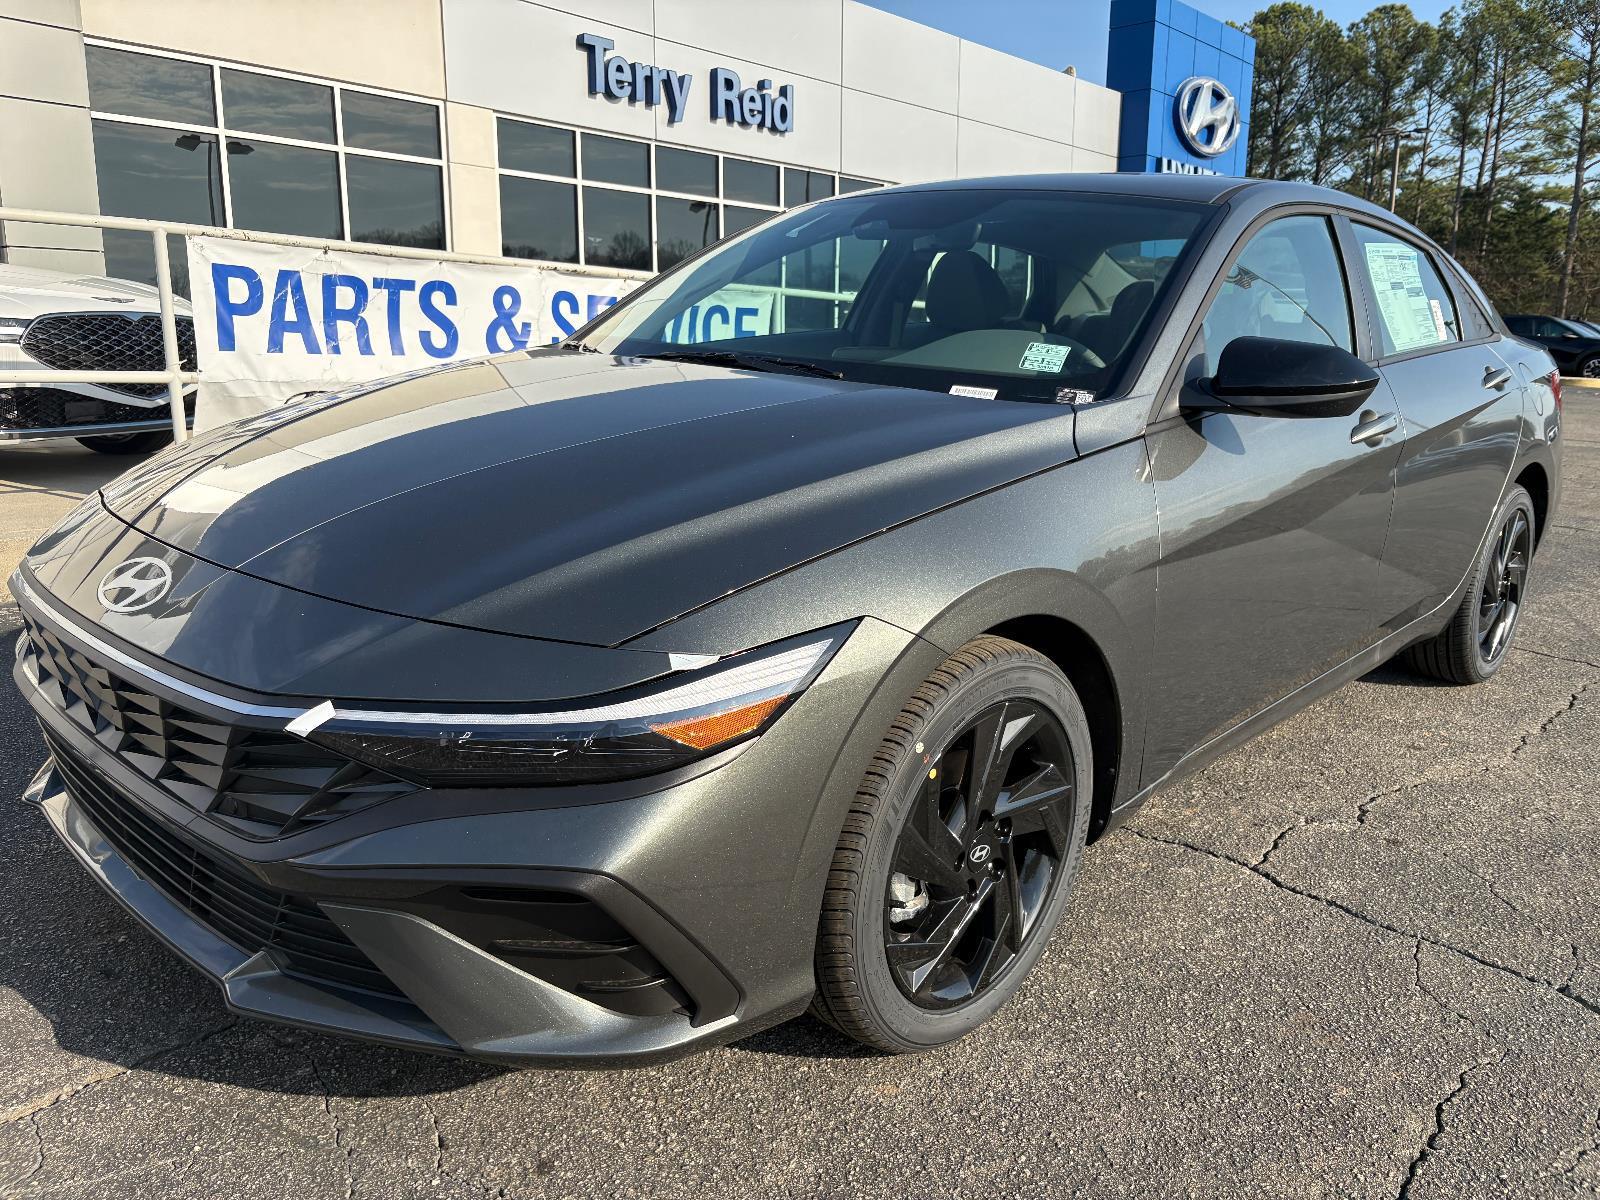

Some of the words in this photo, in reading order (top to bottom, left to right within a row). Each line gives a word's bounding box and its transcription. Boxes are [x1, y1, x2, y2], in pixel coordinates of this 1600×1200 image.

[576, 33, 693, 124] Terry
[709, 67, 795, 134] Reid
[211, 262, 460, 360] PARTS
[485, 284, 533, 352] &
[552, 290, 760, 346] SICE
